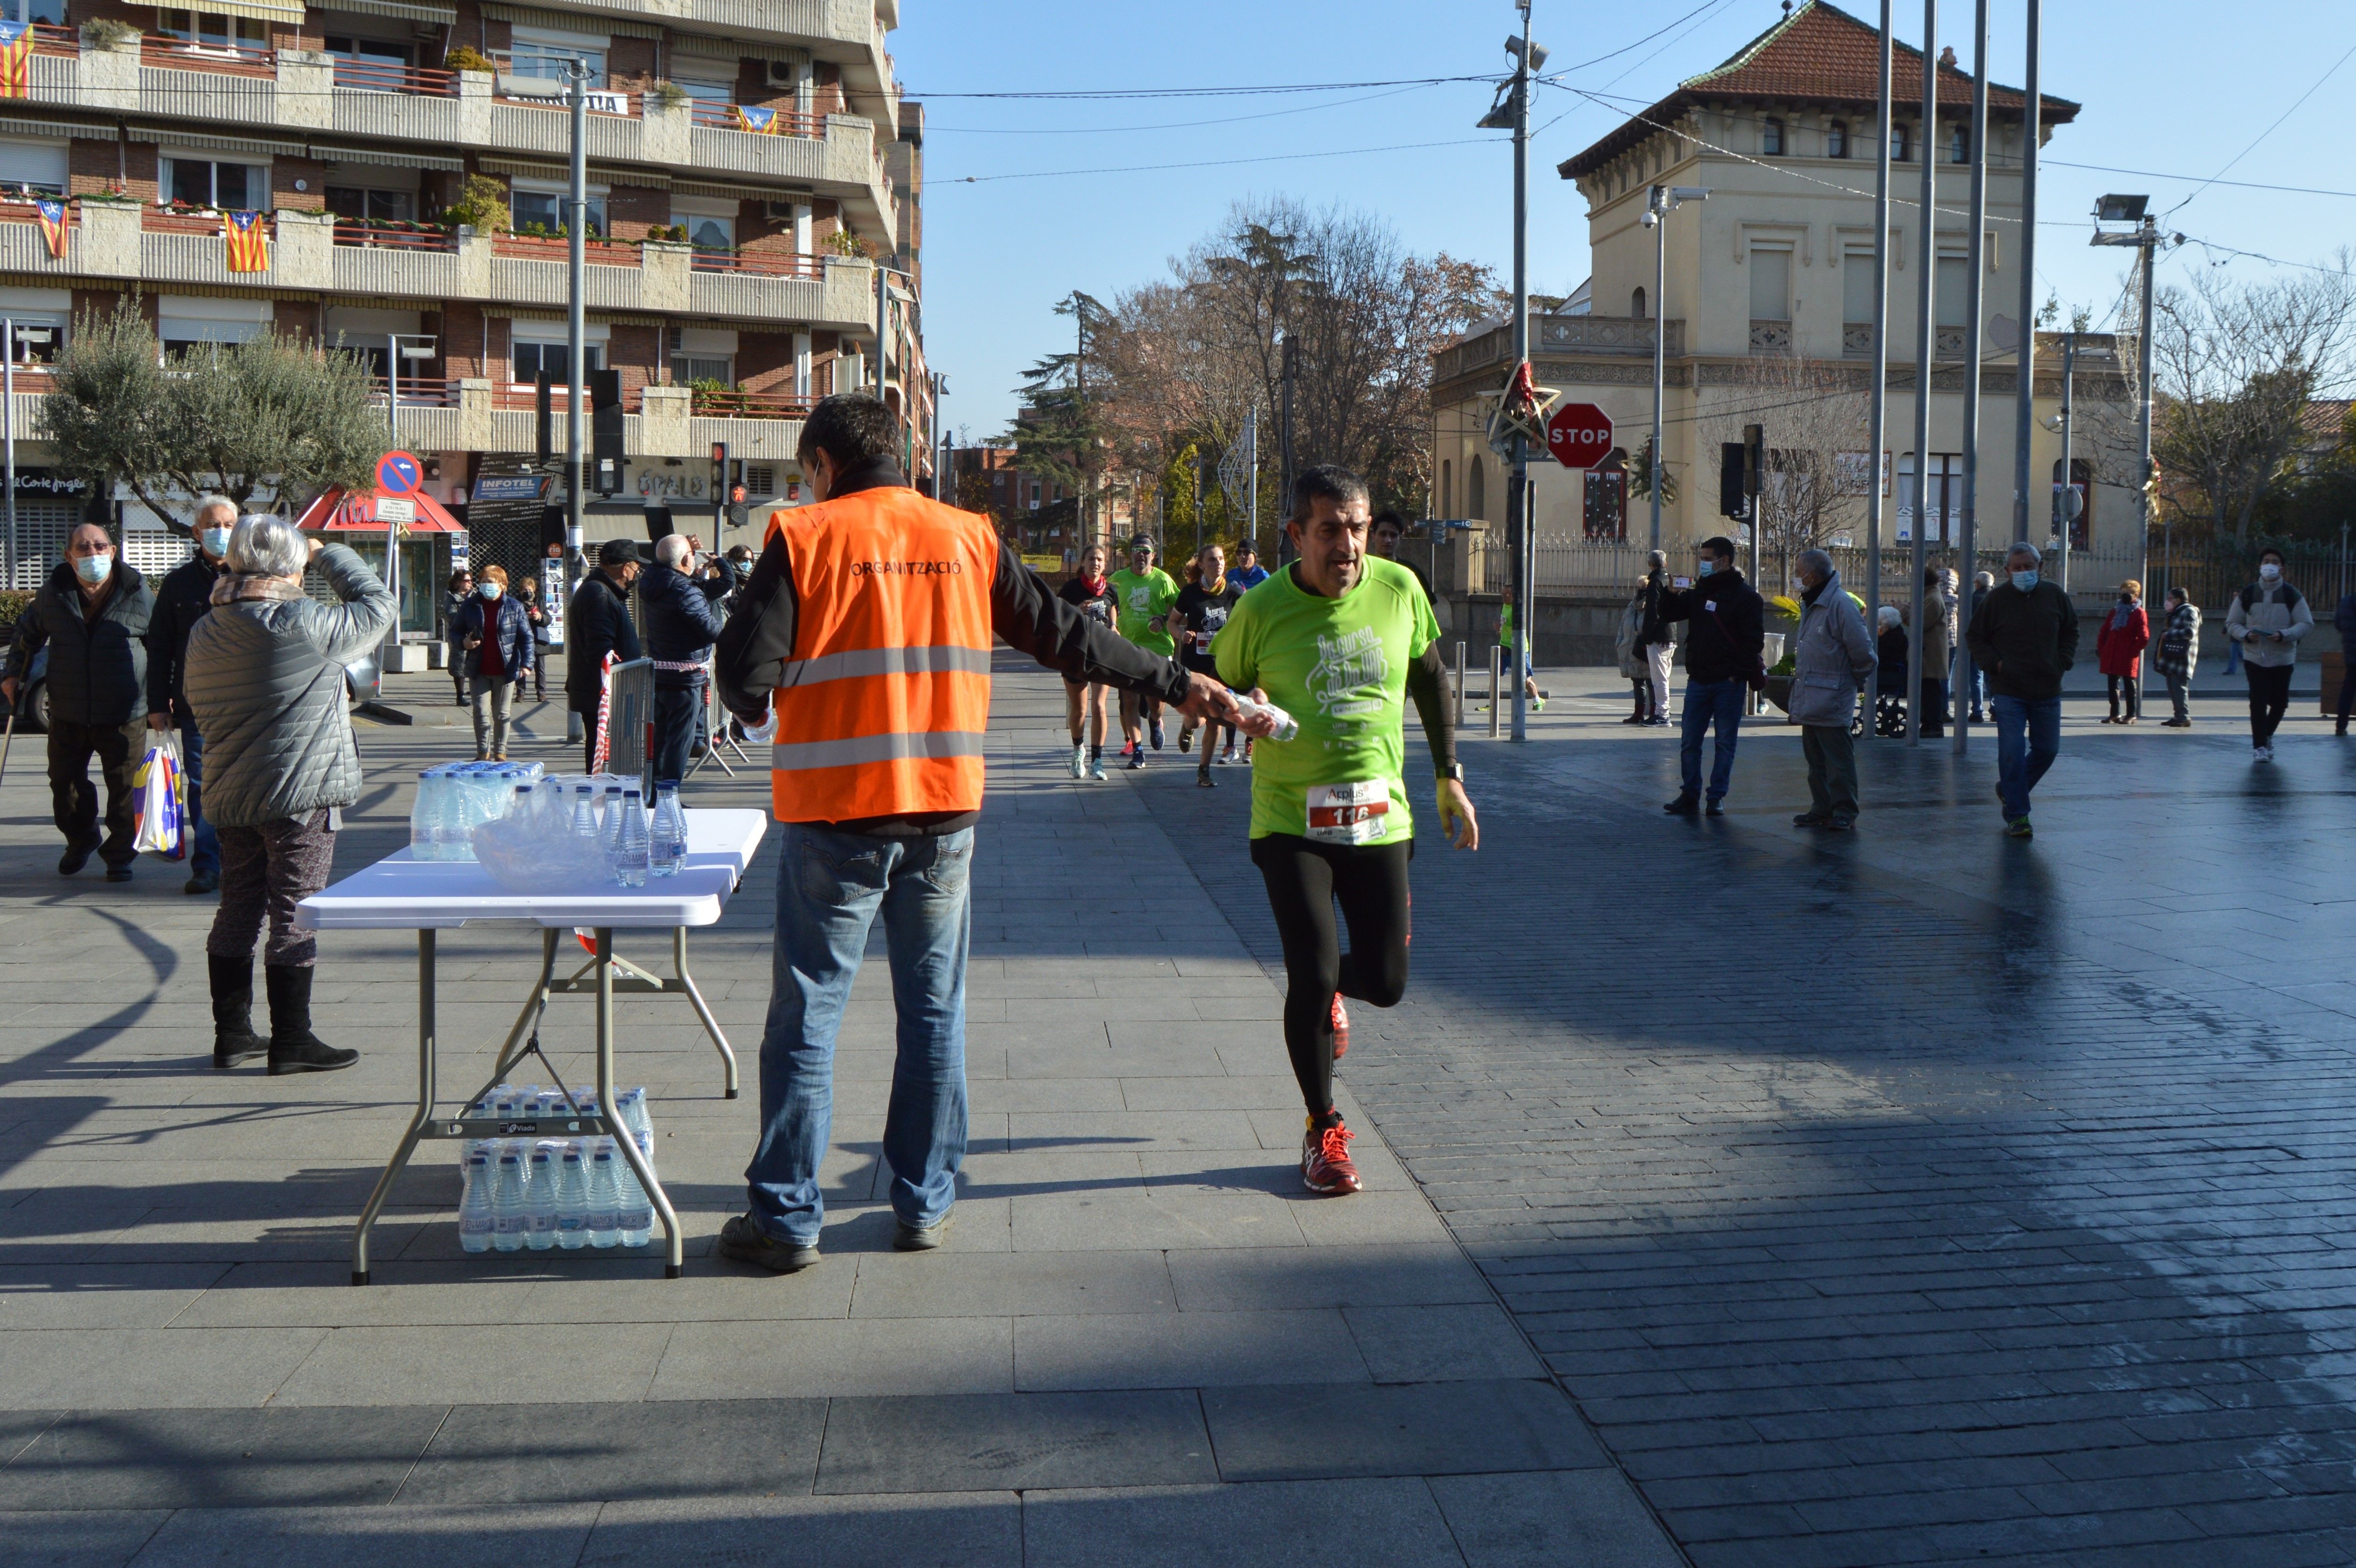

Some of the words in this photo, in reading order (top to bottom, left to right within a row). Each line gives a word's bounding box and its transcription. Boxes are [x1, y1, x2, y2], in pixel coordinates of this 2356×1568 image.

[1551, 428, 1609, 444] STOP
[850, 559, 961, 576] ORGANITZACIÓ
[1334, 806, 1369, 824] 116
